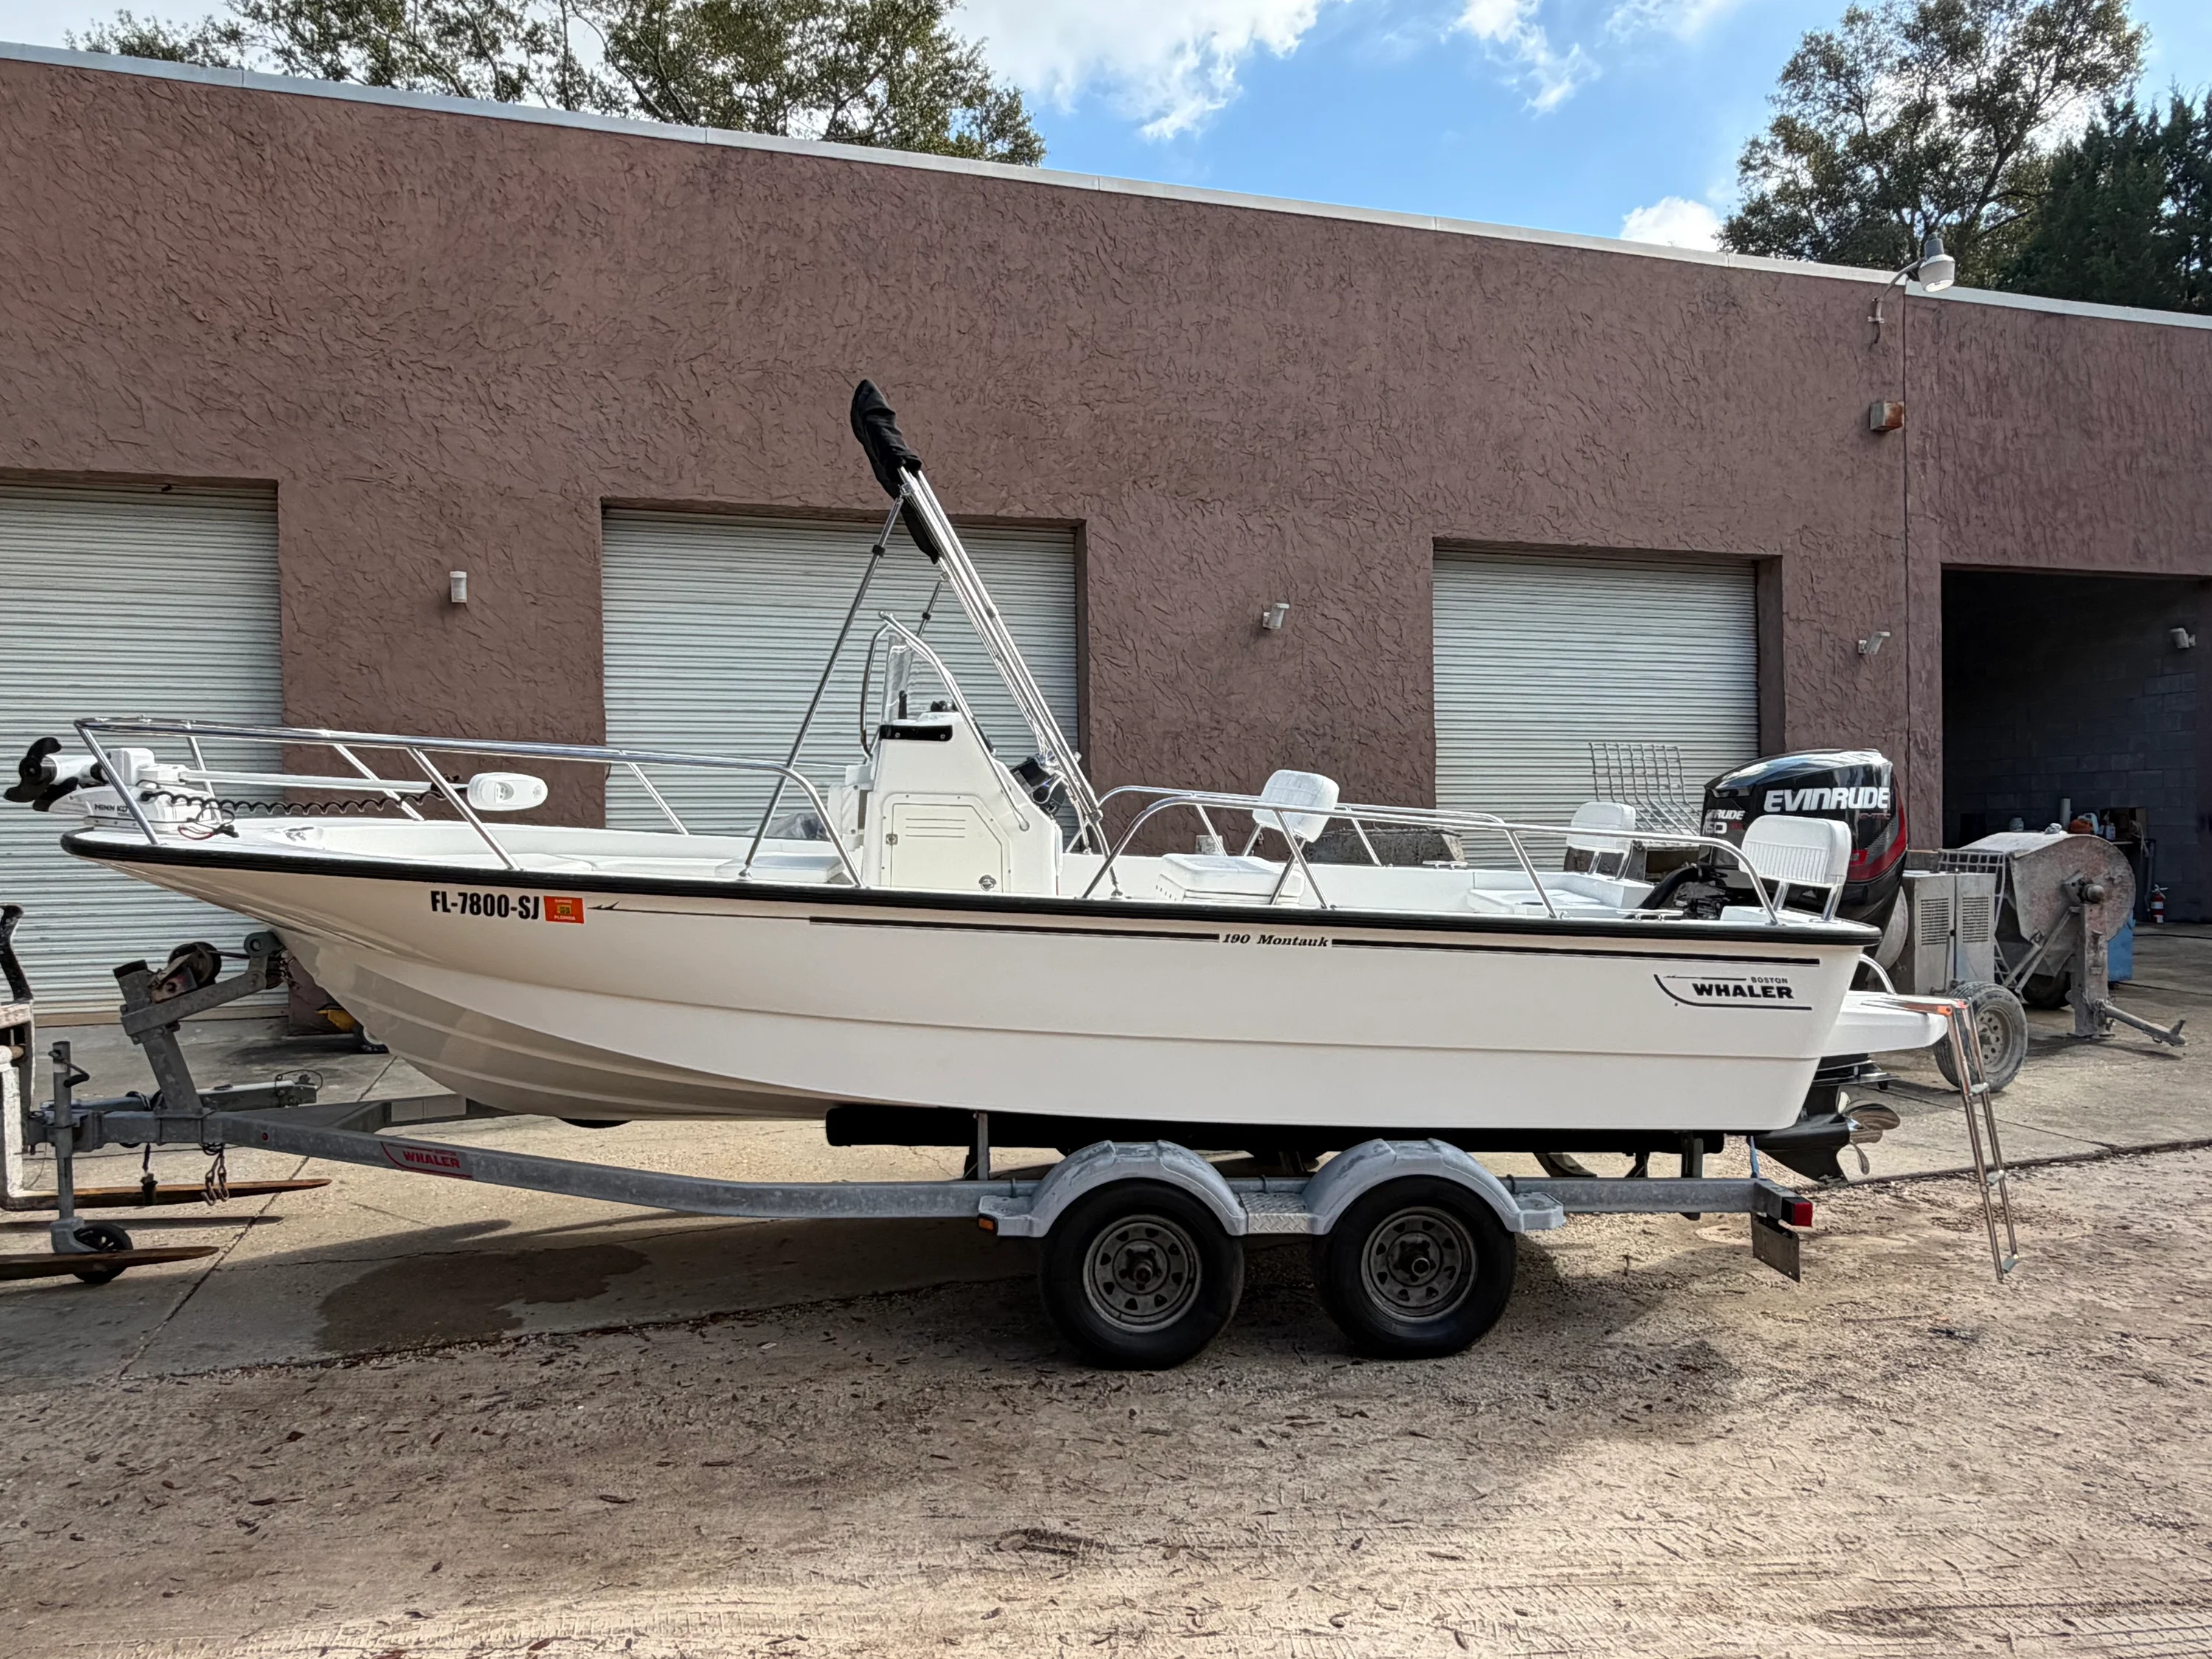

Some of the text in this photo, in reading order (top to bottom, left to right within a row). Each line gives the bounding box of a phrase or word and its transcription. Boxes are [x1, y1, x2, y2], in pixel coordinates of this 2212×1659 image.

[1764, 787, 1891, 812] EVINRUDE
[431, 891, 540, 920] FL-7800-SJ
[1222, 933, 1329, 947] 190 Montauk
[1750, 976, 1788, 984] BOSTON
[1691, 983, 1795, 999] WHALER
[402, 1151, 461, 1169] WHALER
